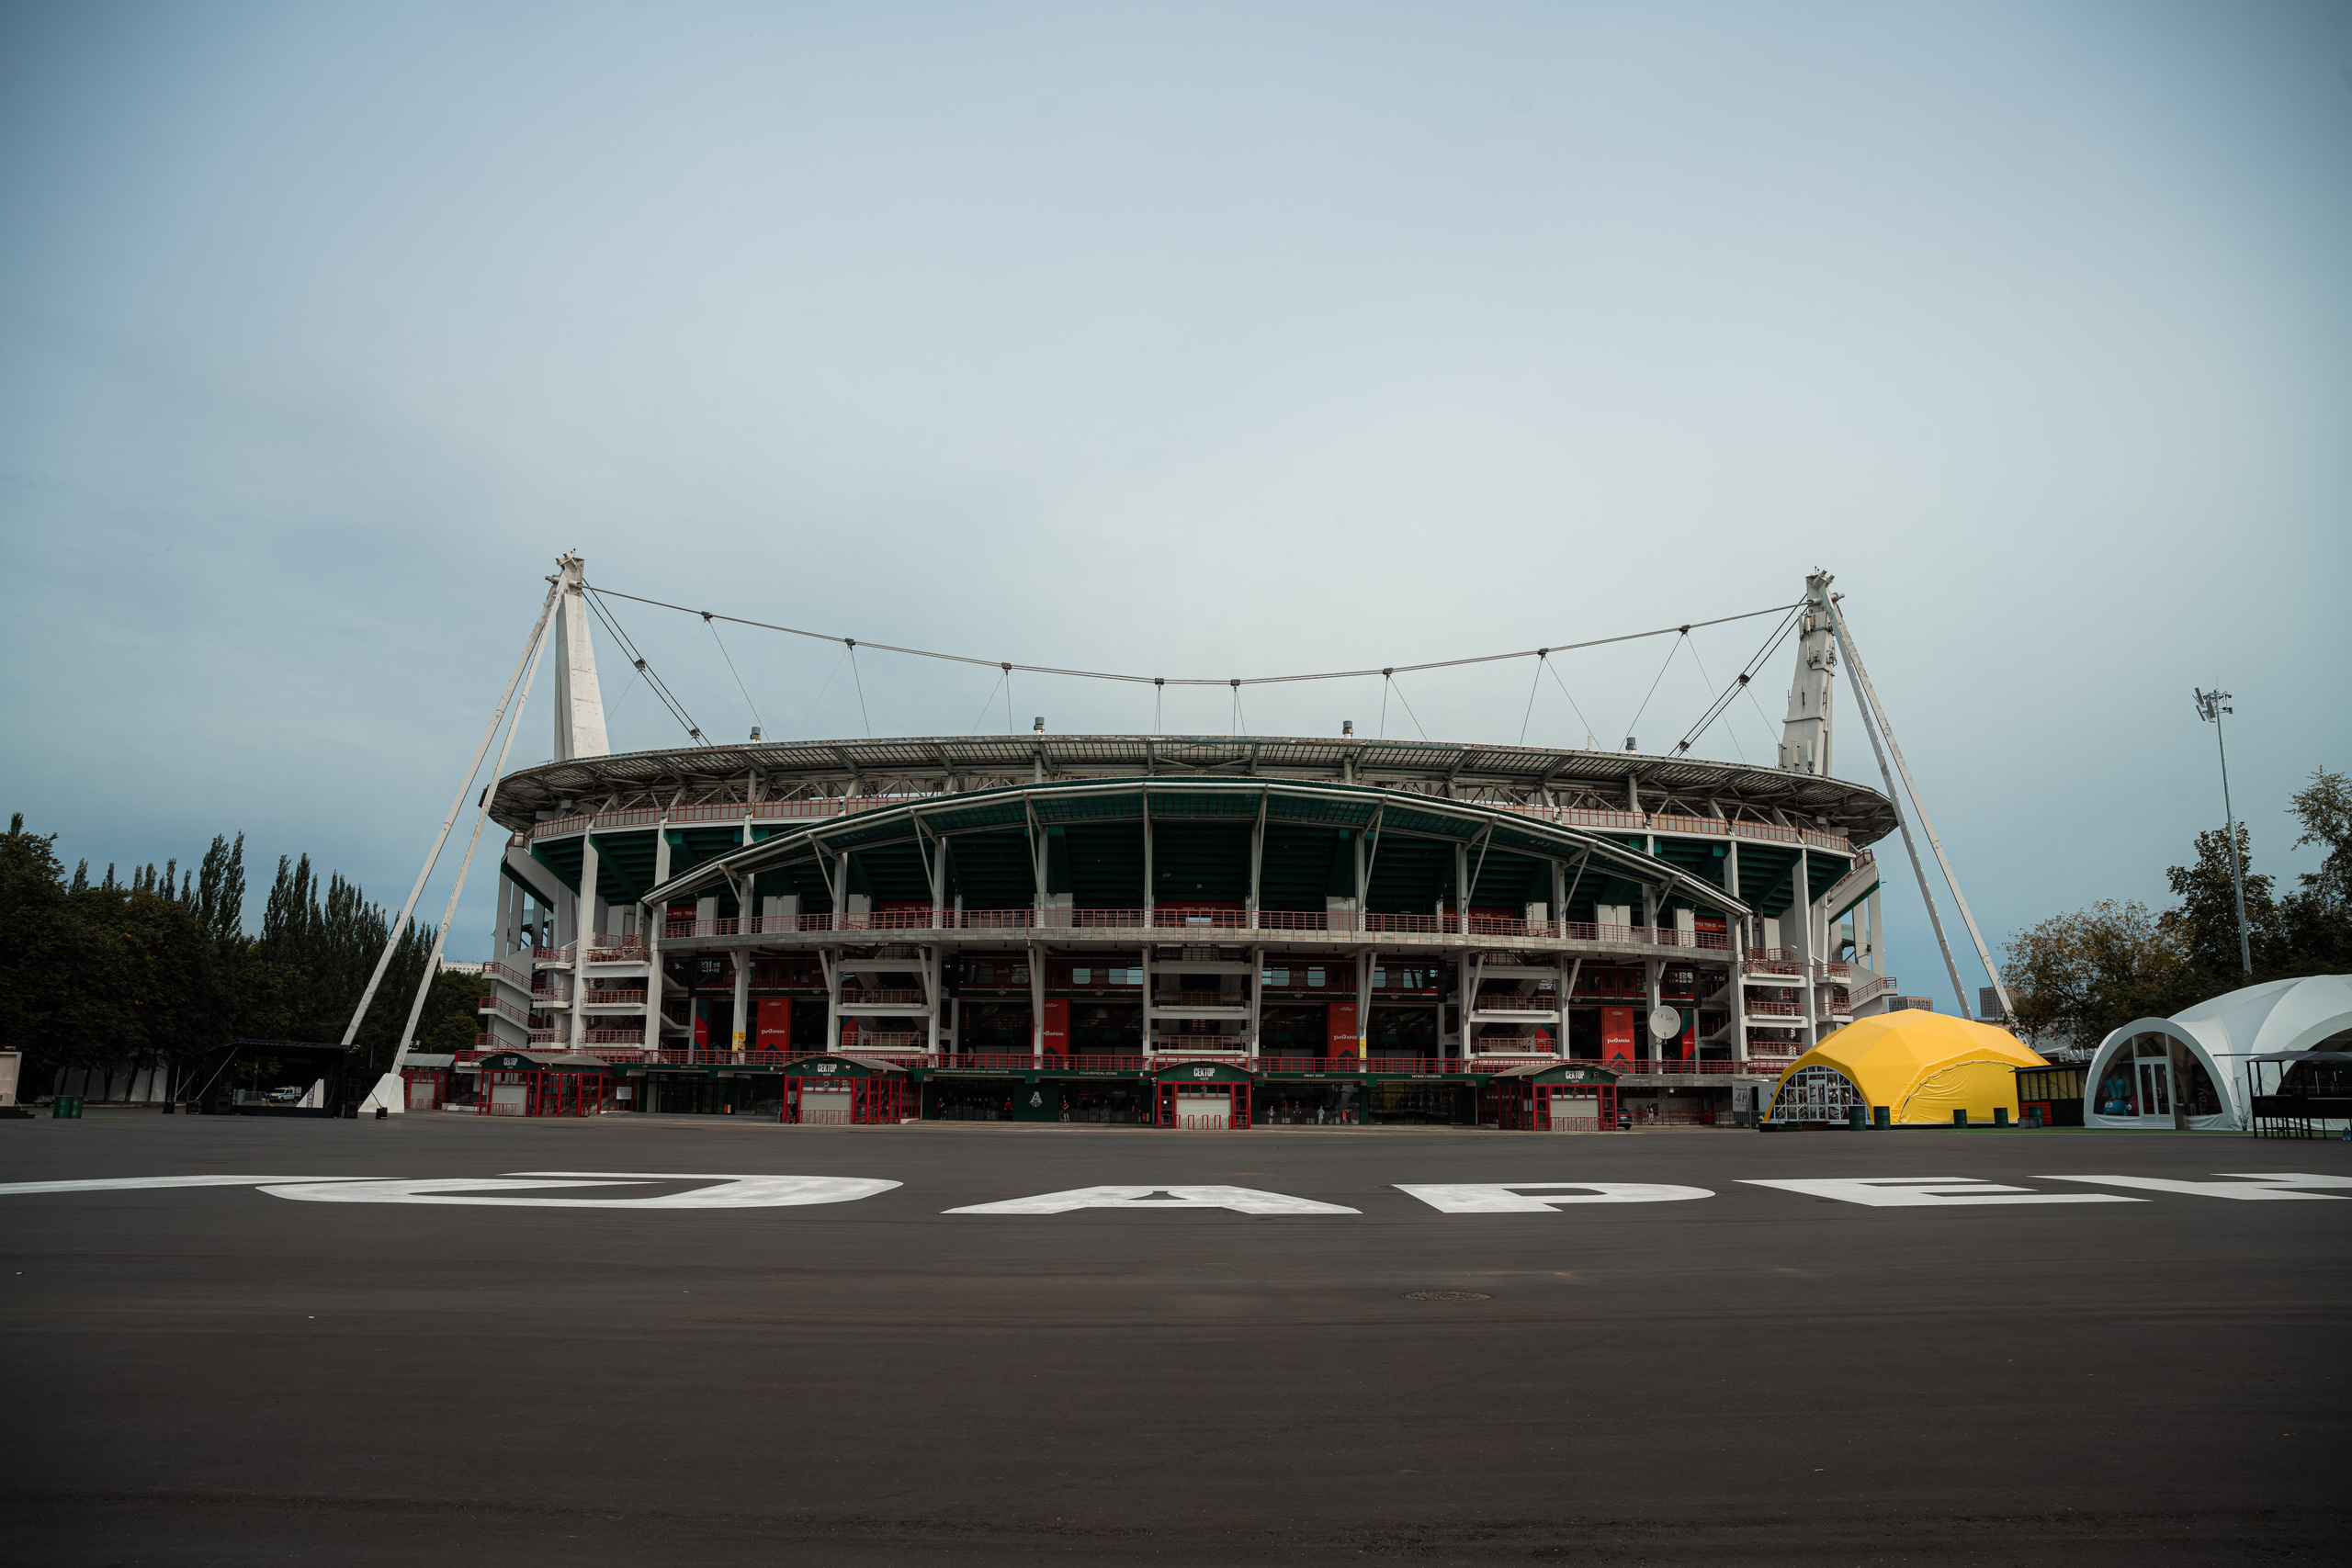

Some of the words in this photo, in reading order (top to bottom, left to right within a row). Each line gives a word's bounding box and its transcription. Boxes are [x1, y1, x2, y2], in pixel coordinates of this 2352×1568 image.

[2058, 1048, 2097, 1062] FANS
[503, 1057, 518, 1066] СЕКТОР
[817, 1063, 838, 1073] СЕКТОР
[1193, 1067, 1216, 1077] СЕКТОР
[1566, 1070, 1585, 1079] СЕКТОР
[1201, 1085, 1207, 1097] 3
